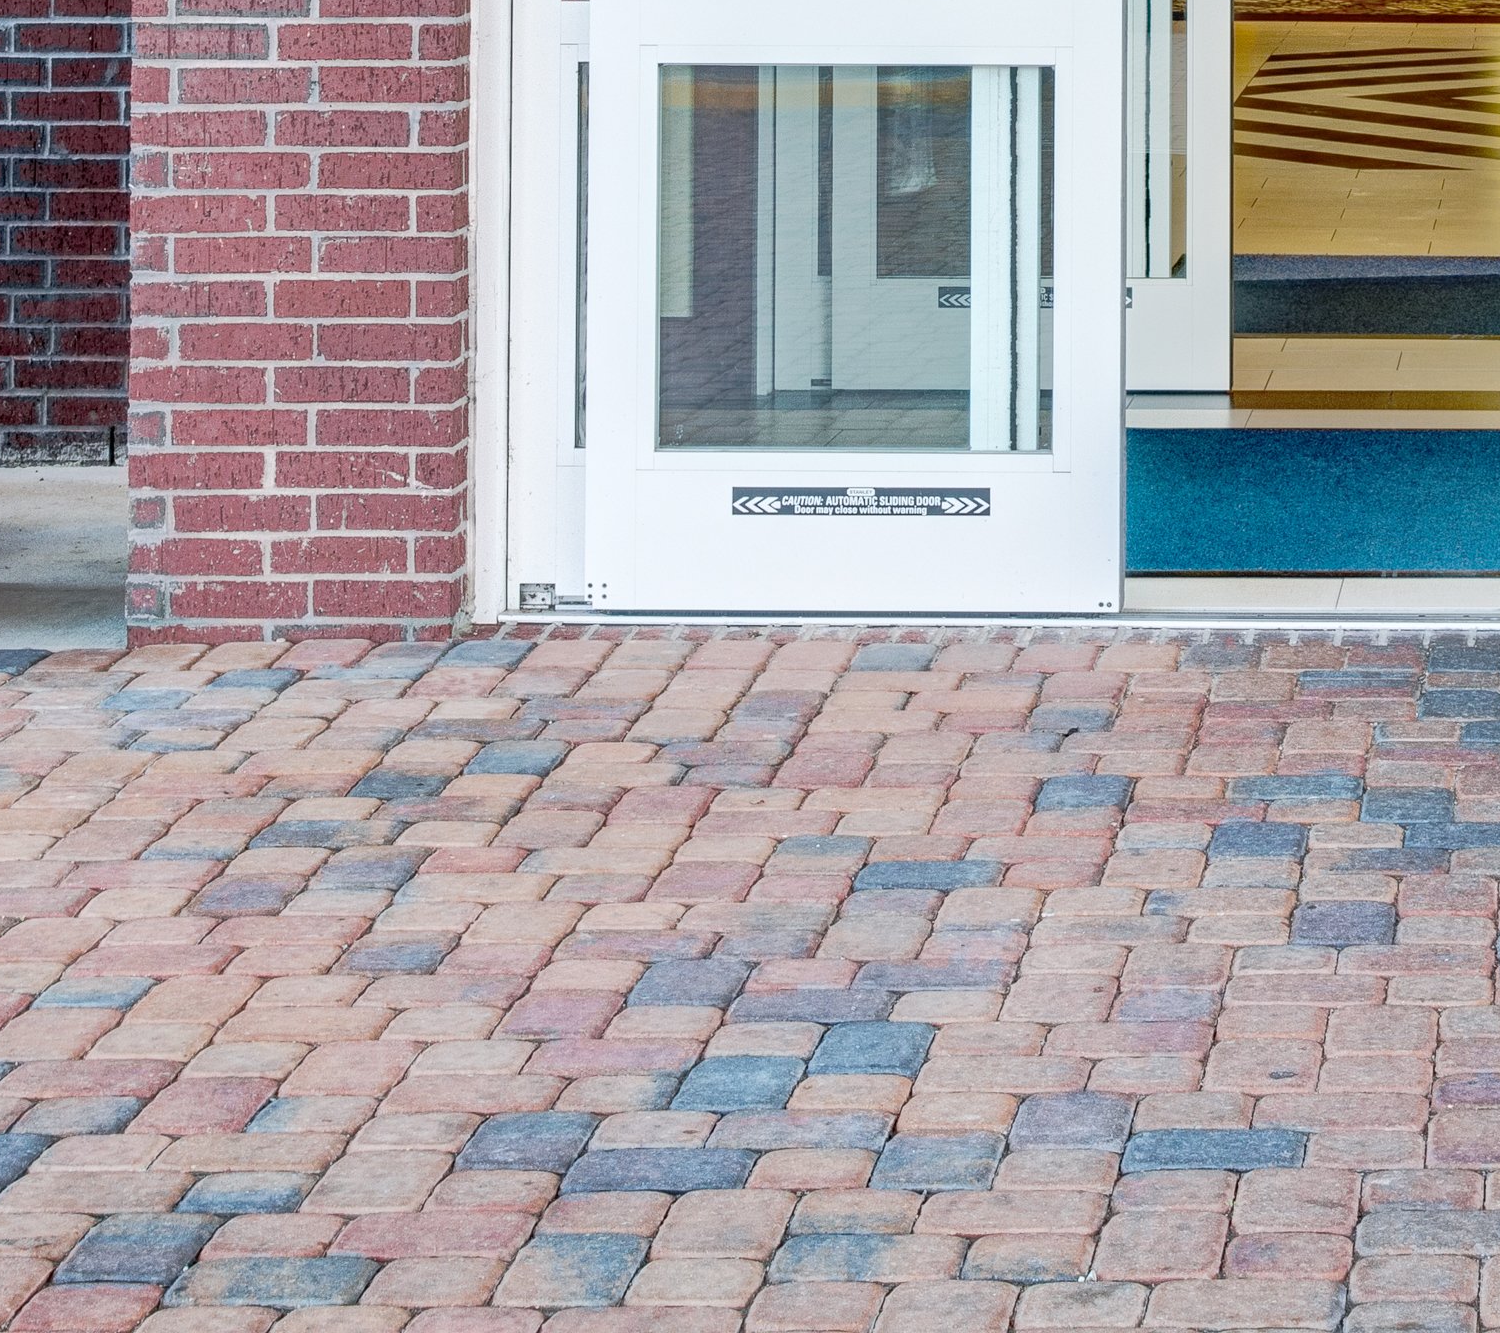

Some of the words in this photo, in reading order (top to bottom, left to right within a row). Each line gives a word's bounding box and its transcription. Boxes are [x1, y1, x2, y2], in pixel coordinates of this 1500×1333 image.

[782, 495, 824, 506] CAUTION:
[825, 495, 878, 506] AUTOMATIC
[879, 496, 915, 506] SLIDING
[916, 496, 941, 506] DOOR
[794, 505, 815, 514] Door
[816, 507, 834, 516] may
[835, 505, 858, 514] close
[859, 505, 892, 514] without
[892, 505, 928, 516] warning
